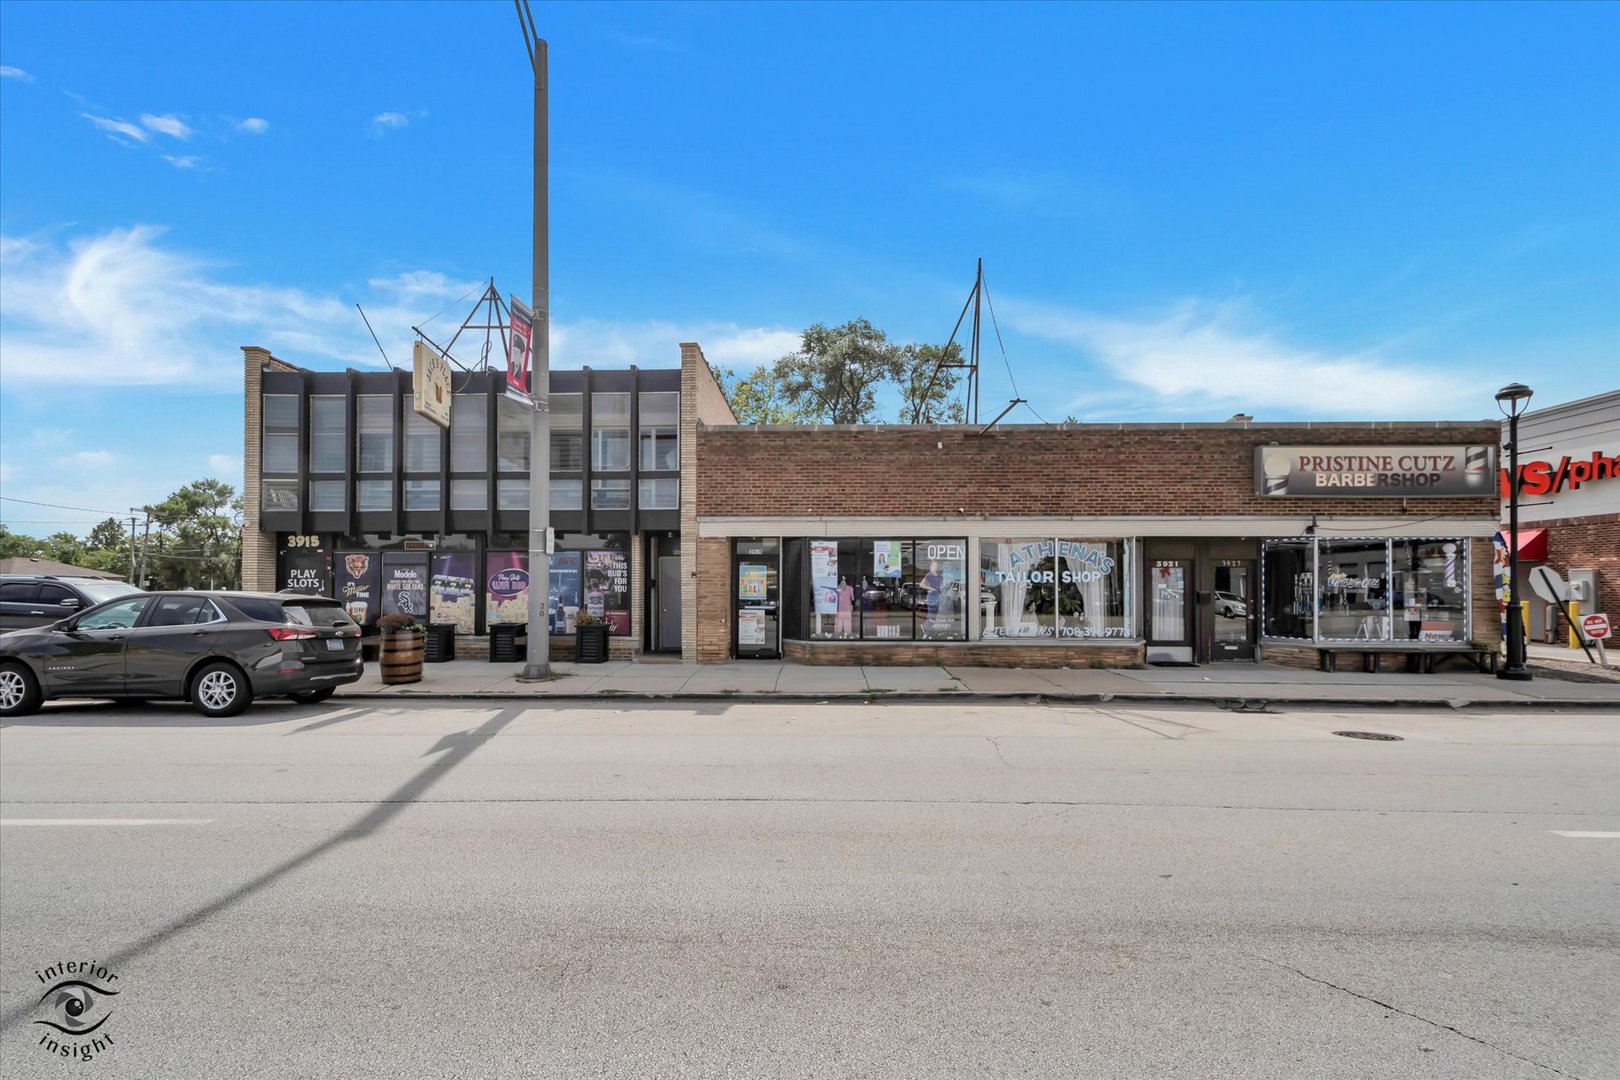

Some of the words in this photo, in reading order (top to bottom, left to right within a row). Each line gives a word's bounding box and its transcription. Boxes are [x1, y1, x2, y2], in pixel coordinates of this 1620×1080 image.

[1299, 456, 1392, 472] PRISTINE
[1398, 456, 1456, 472] CUTZ
[1316, 473, 1441, 487] BARBERSHOP
[287, 535, 320, 547] 3915
[927, 545, 965, 560] OPEN
[1008, 540, 1115, 576] ATHENA'S
[290, 569, 317, 578] PLAY
[393, 569, 417, 578] Modelo
[995, 571, 1054, 584] TAILOR
[1062, 571, 1101, 583] SHOP
[287, 579, 320, 588] SLOTS
[742, 585, 763, 593] SALE
